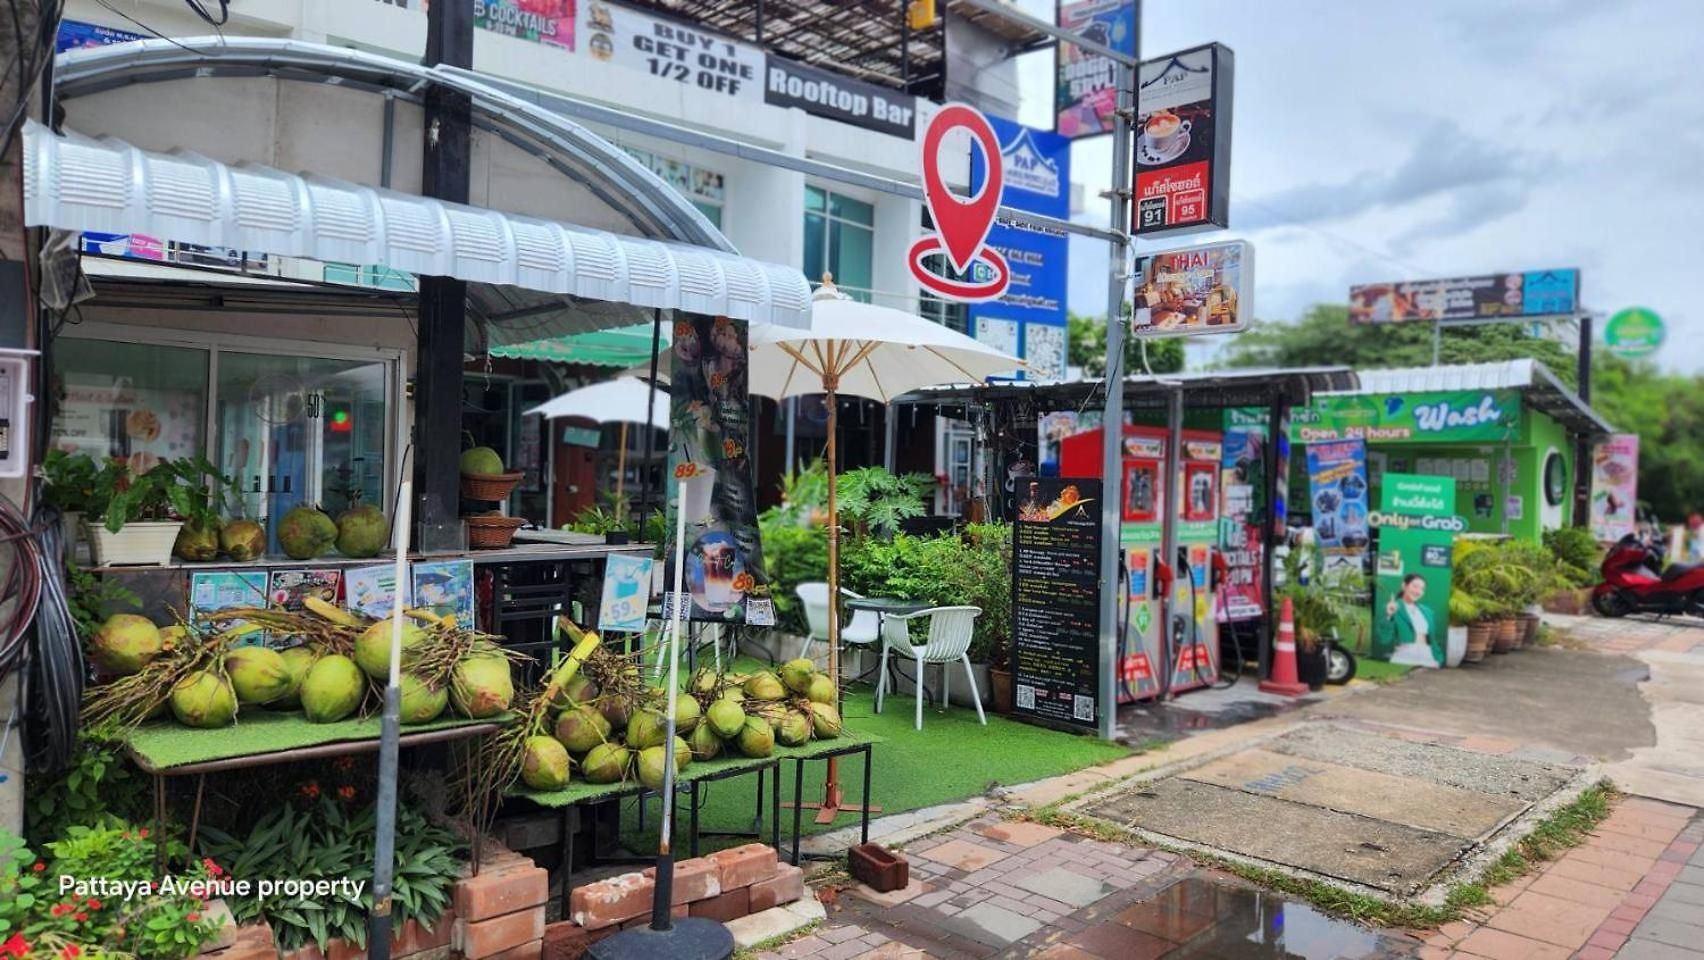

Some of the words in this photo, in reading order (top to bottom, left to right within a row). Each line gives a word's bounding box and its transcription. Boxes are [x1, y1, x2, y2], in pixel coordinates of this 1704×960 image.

[489, 3, 557, 36] COCKTAILS
[653, 23, 714, 50] BUY
[721, 42, 736, 57] 1
[633, 35, 690, 62] GET
[698, 53, 753, 80] ONE
[646, 58, 690, 84] 1/2
[697, 71, 741, 96] OFF
[769, 67, 868, 116] Rooftop
[872, 95, 913, 127] Bar
[1013, 154, 1039, 172] PAP
[1144, 208, 1162, 222] 91
[1182, 204, 1195, 216] 95
[1169, 251, 1209, 271] THAI
[1414, 396, 1500, 432] Wash
[1300, 427, 1338, 442] Open
[1345, 426, 1364, 439] 24
[1366, 425, 1410, 439] hours
[1368, 511, 1409, 530] Only
[1421, 515, 1464, 531] Grab
